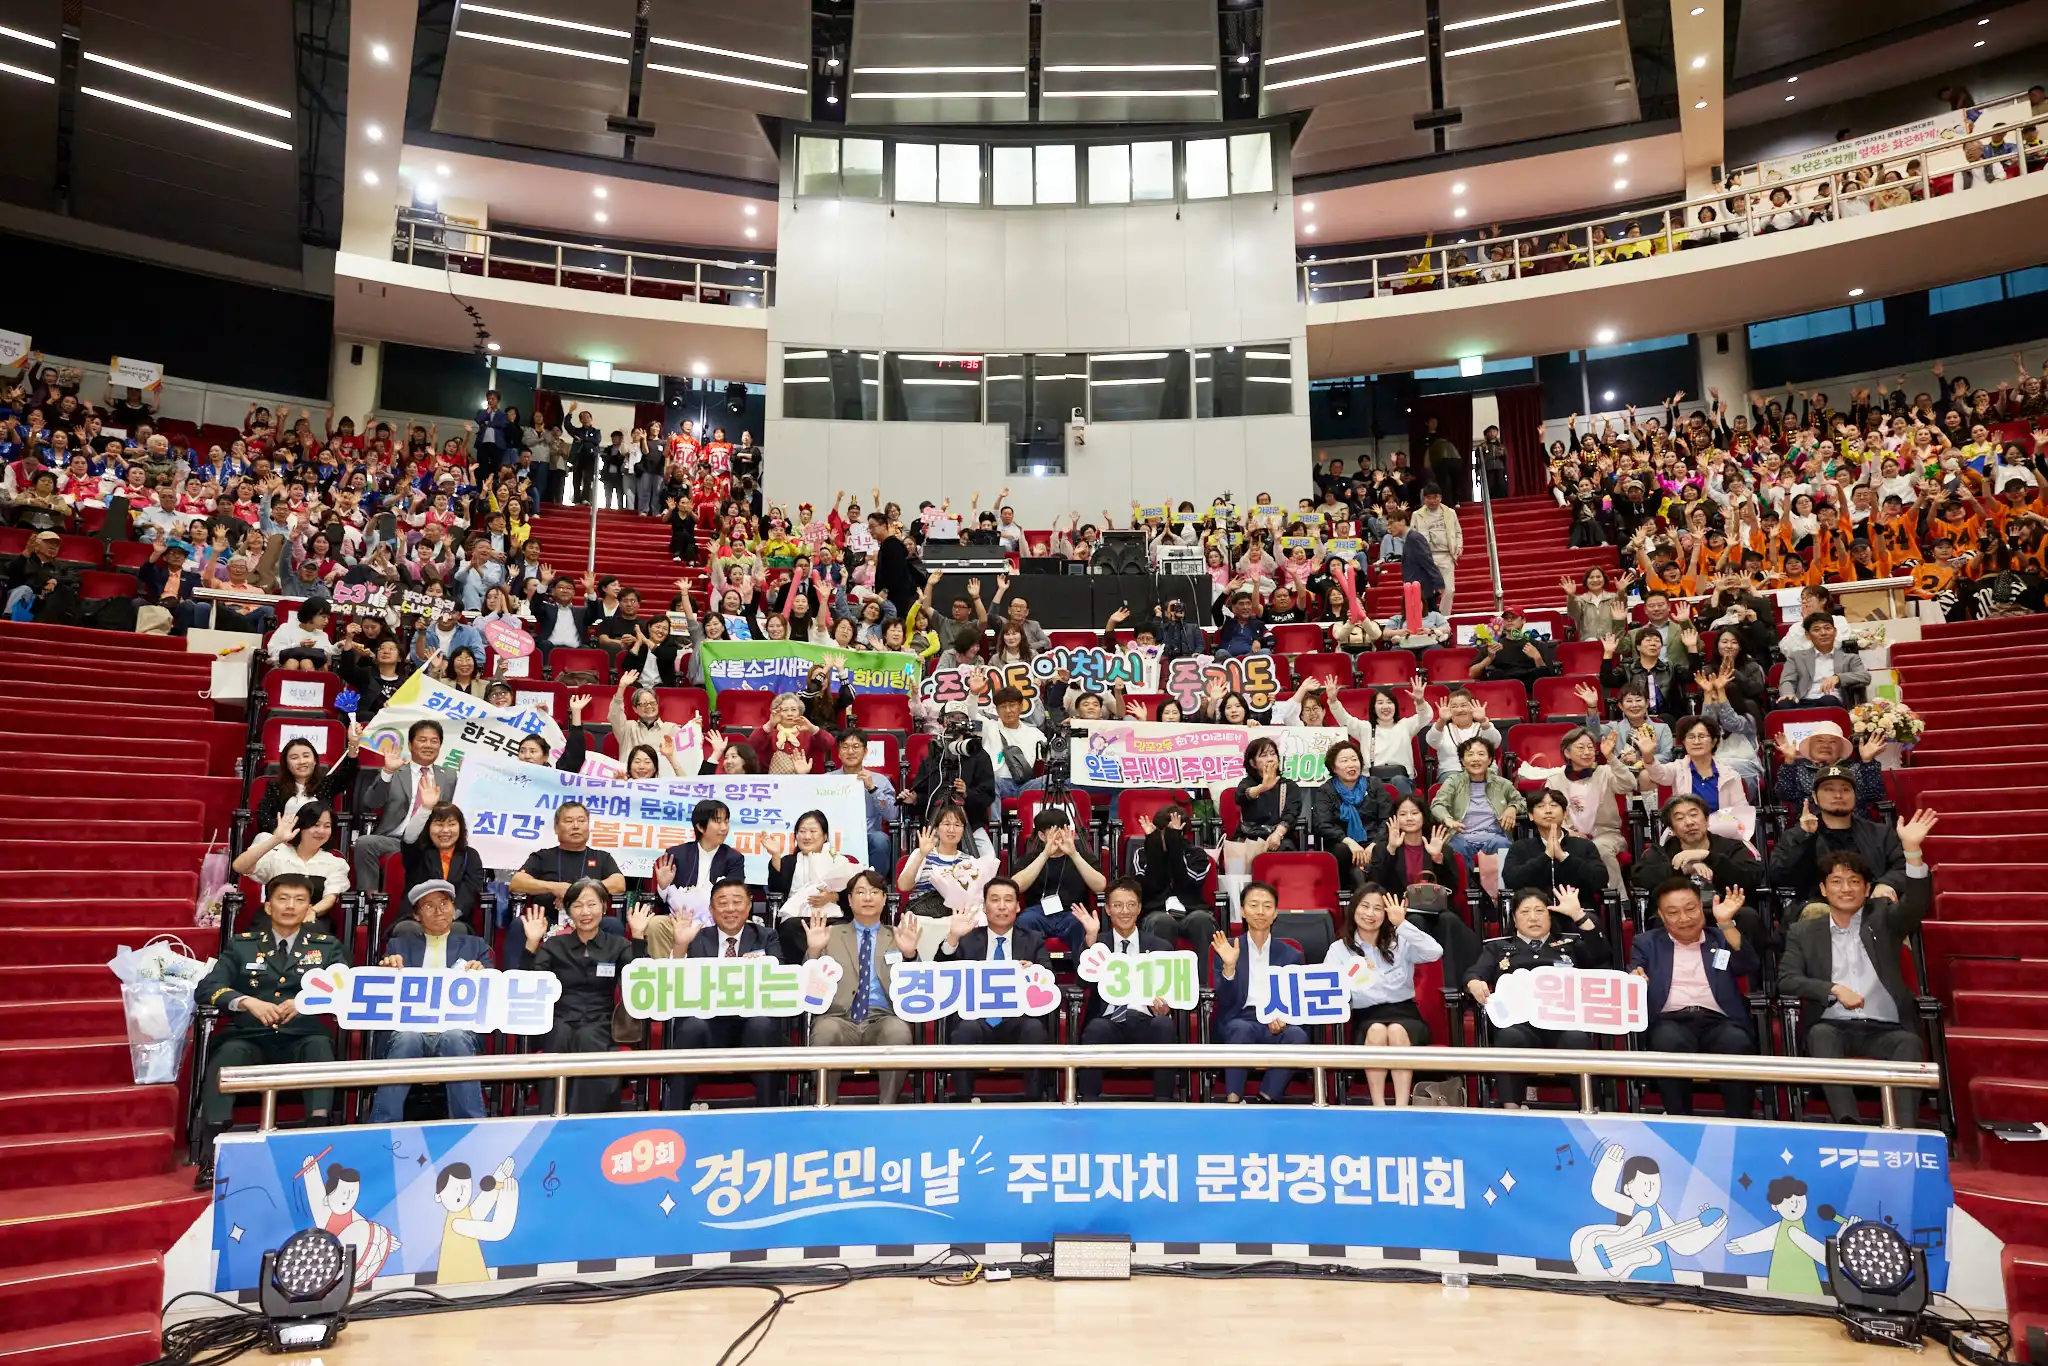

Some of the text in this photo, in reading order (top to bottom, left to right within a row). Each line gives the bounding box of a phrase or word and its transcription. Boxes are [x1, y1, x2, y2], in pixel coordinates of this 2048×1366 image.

[852, 668, 911, 691] 화이팅!
[1033, 647, 1141, 691] 이천시
[1084, 754, 1122, 782] 오늘
[1121, 756, 1179, 783] 무대의
[473, 810, 546, 841] 최강
[732, 830, 842, 856] 파이!
[347, 975, 554, 1026] 도민의 날
[629, 965, 799, 1013] 하나되는
[897, 967, 1018, 1013] 경기도
[1105, 957, 1191, 1002] 31개
[1263, 971, 1343, 1017] 시군
[1534, 973, 1640, 1026] 원팀!
[610, 1138, 676, 1176] 제9회
[1883, 1151, 1940, 1170] 경기도
[691, 1146, 1466, 1217] 경기도민의 날 주민자치 문화경연대회
